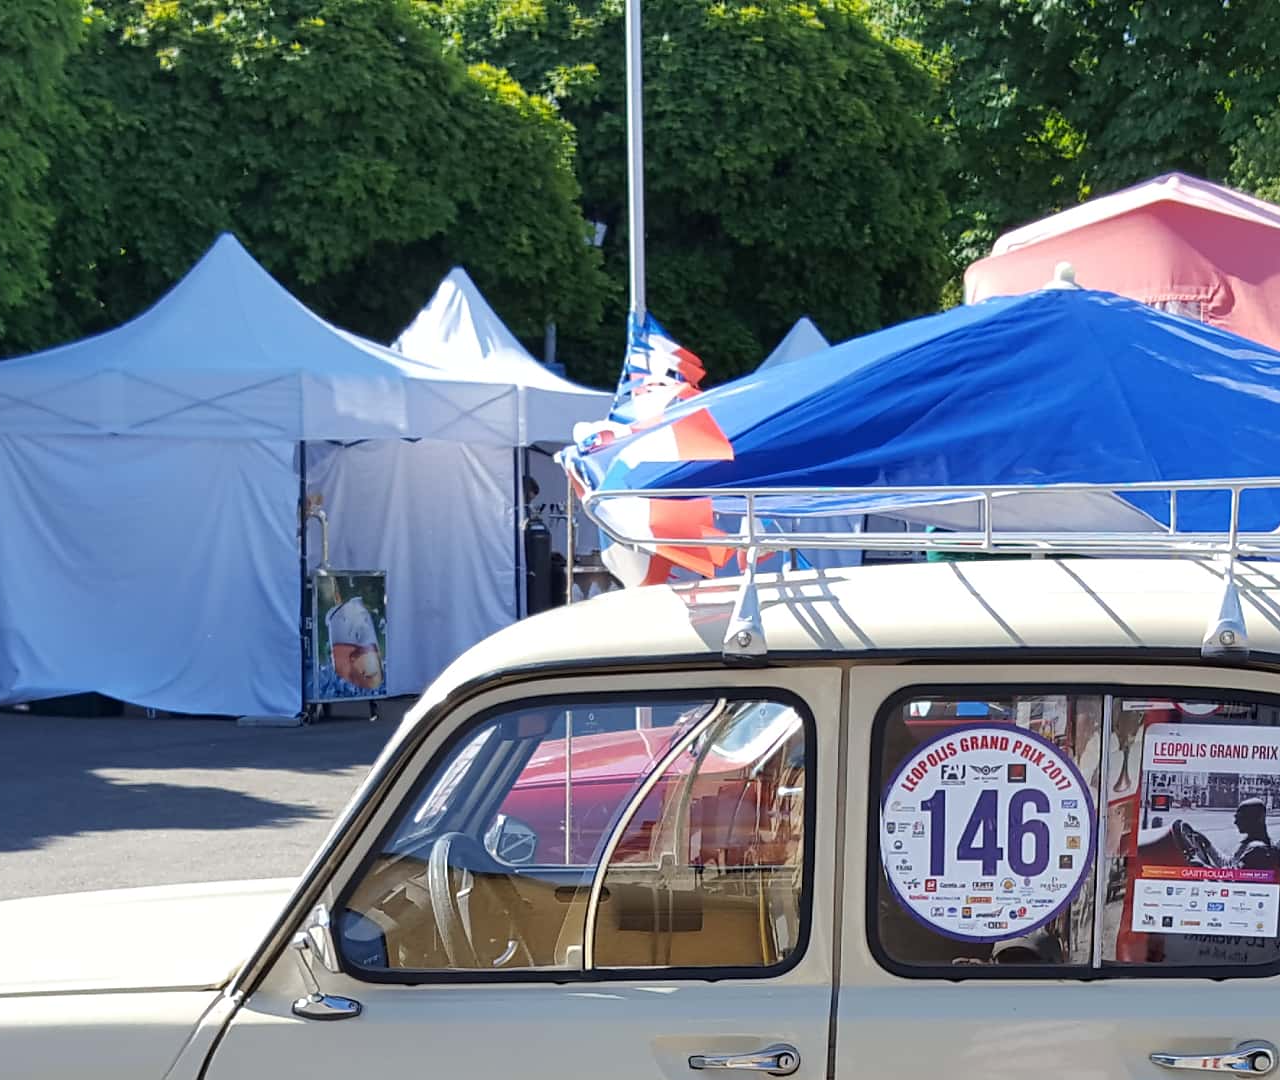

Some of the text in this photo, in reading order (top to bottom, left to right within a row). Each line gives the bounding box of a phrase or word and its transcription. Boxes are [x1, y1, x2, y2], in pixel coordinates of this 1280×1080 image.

[900, 735, 1073, 793] LEOPOLIS GRAND PRIX 2017
[1154, 742, 1279, 760] LEOPOLIS GRAND PRIX
[920, 788, 1051, 878] 146
